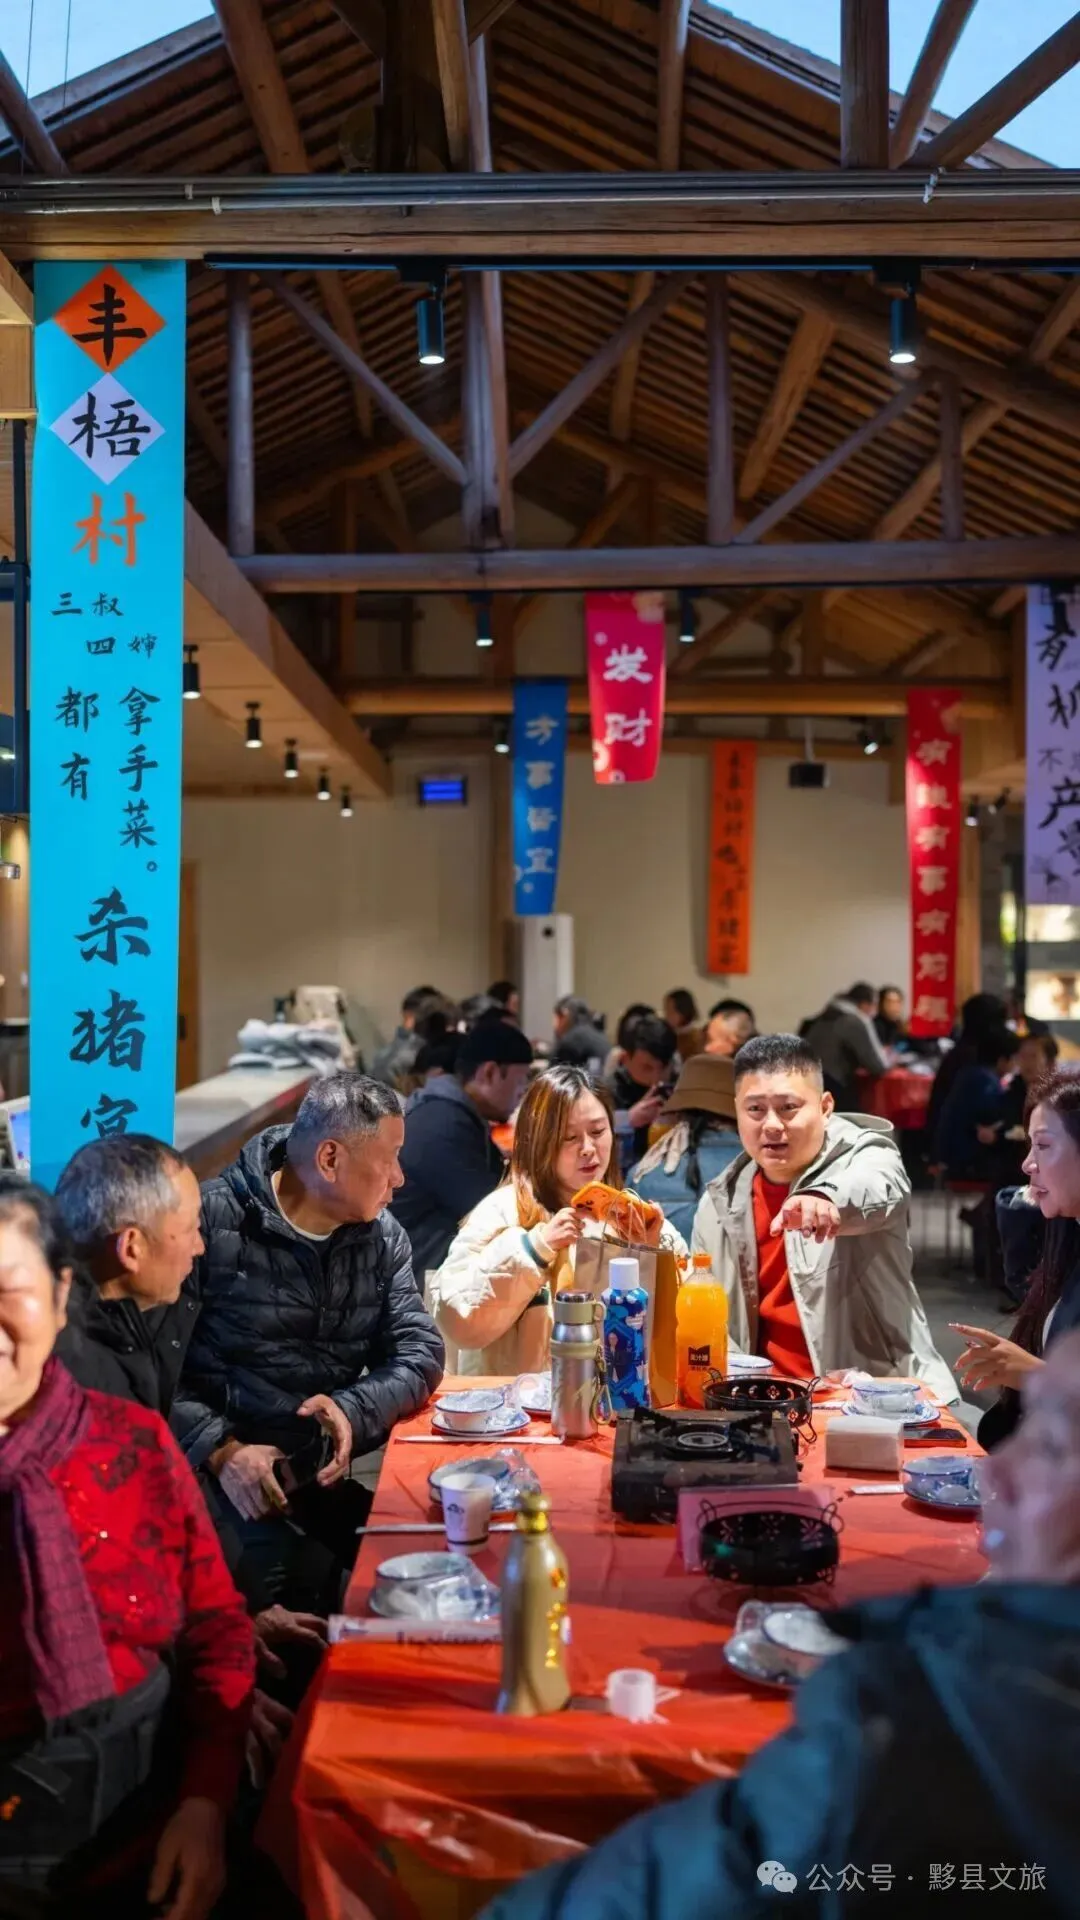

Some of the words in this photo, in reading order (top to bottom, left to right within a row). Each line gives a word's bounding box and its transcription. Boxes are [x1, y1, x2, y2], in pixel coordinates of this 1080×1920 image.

[69, 283, 151, 567] 丰梧村
[51, 592, 124, 617] 三叔
[55, 686, 99, 800] 都有
[603, 644, 653, 747] 发财
